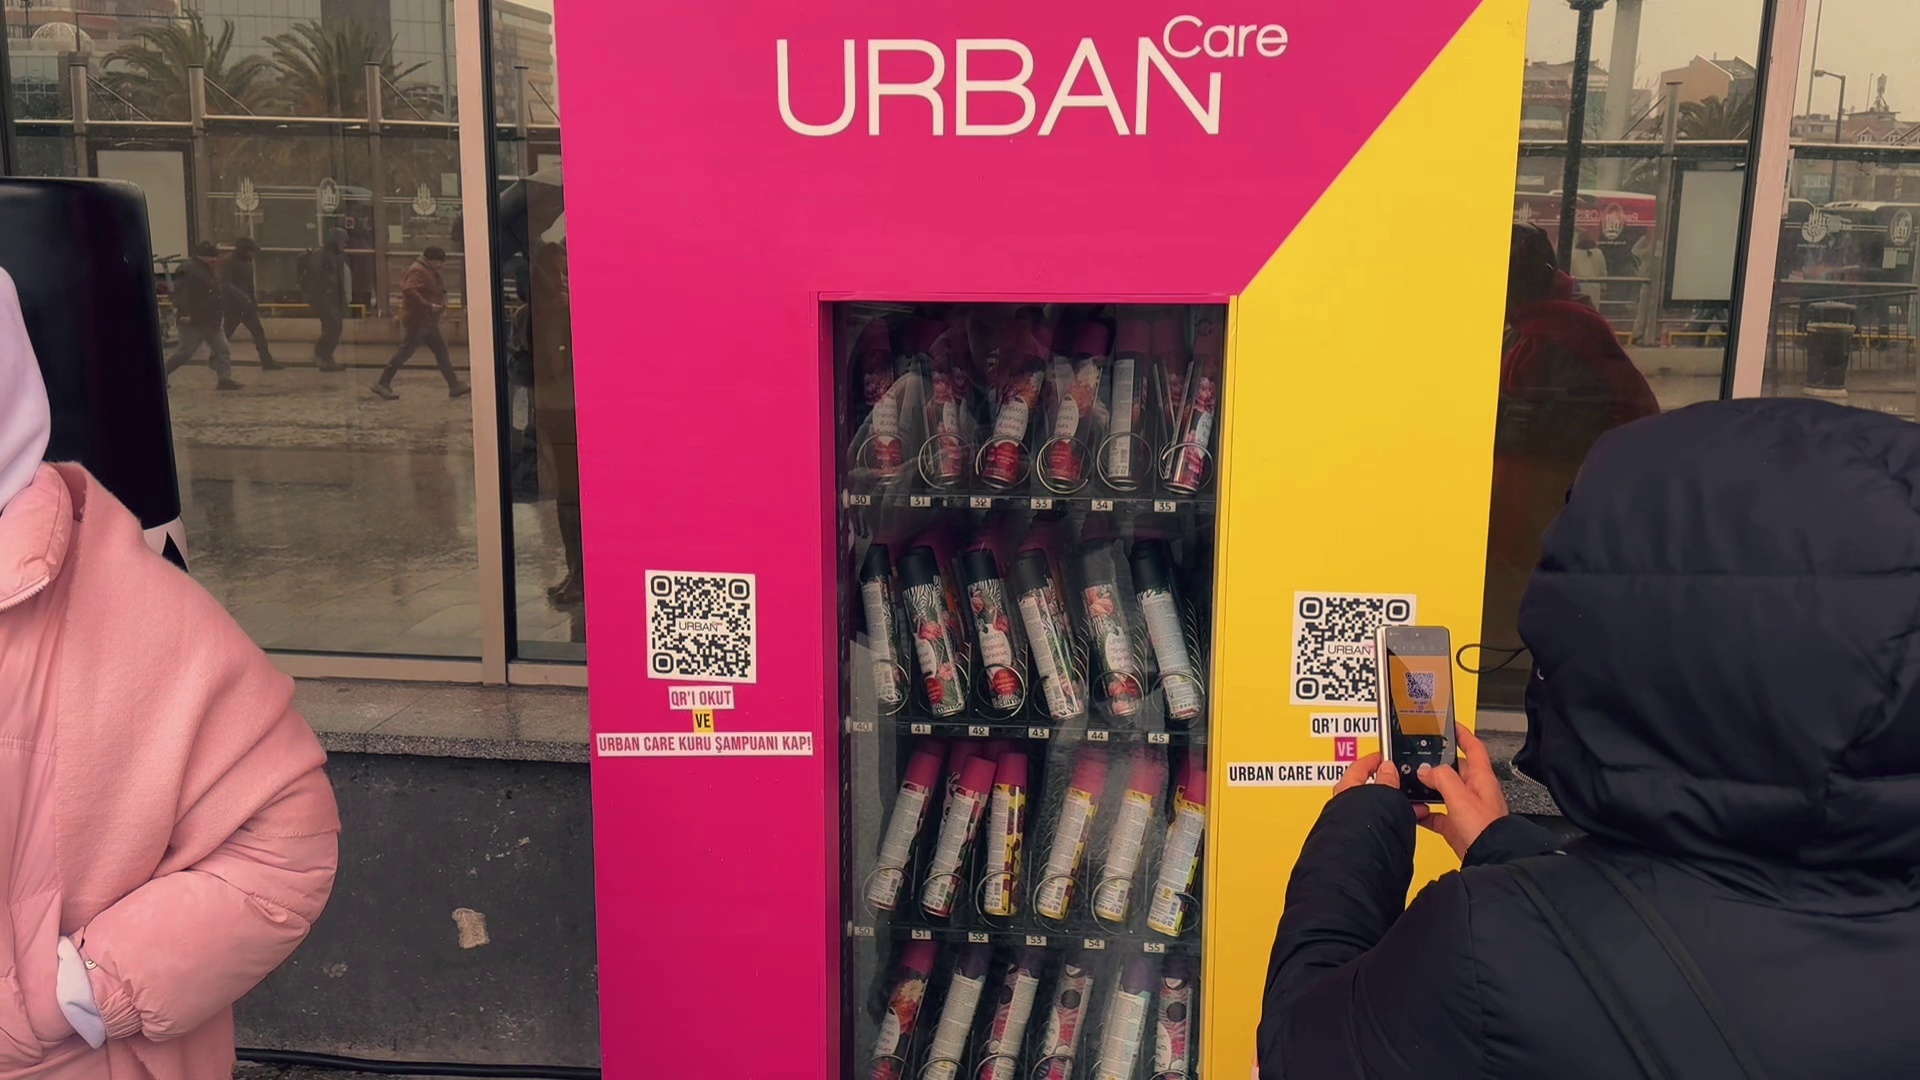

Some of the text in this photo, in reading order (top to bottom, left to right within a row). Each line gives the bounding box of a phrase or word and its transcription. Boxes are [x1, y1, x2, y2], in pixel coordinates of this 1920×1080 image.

[776, 15, 1289, 137] URBAN Care
[855, 496, 867, 504] 30
[915, 497, 925, 505] 31
[974, 498, 987, 507] 32
[1035, 500, 1048, 508] 33
[1096, 501, 1108, 510] 34
[1159, 502, 1171, 511] 35
[678, 621, 718, 632] URBAN
[1327, 644, 1371, 655] URBAN
[671, 690, 732, 707] QR'I OKUT
[695, 713, 711, 728] VE
[1343, 717, 1378, 733] OKUT
[856, 722, 869, 731] 40
[914, 724, 926, 733] 41
[972, 727, 985, 735] 42
[1032, 729, 1045, 737] 43
[1091, 732, 1104, 740] 44
[1152, 734, 1165, 742] 45
[599, 736, 811, 753] URBAN CARE KURU ŞAMPUANI KAP!
[1337, 741, 1355, 757] VE
[1229, 766, 1274, 781] URBAN
[1278, 765, 1313, 781] CARE
[1317, 765, 1349, 781] KUR
[858, 927, 870, 935] 50
[915, 929, 926, 938] 51
[972, 932, 984, 941] 52
[1030, 935, 1042, 944] 53
[1088, 939, 1100, 947] 54
[1148, 942, 1160, 951] 55
